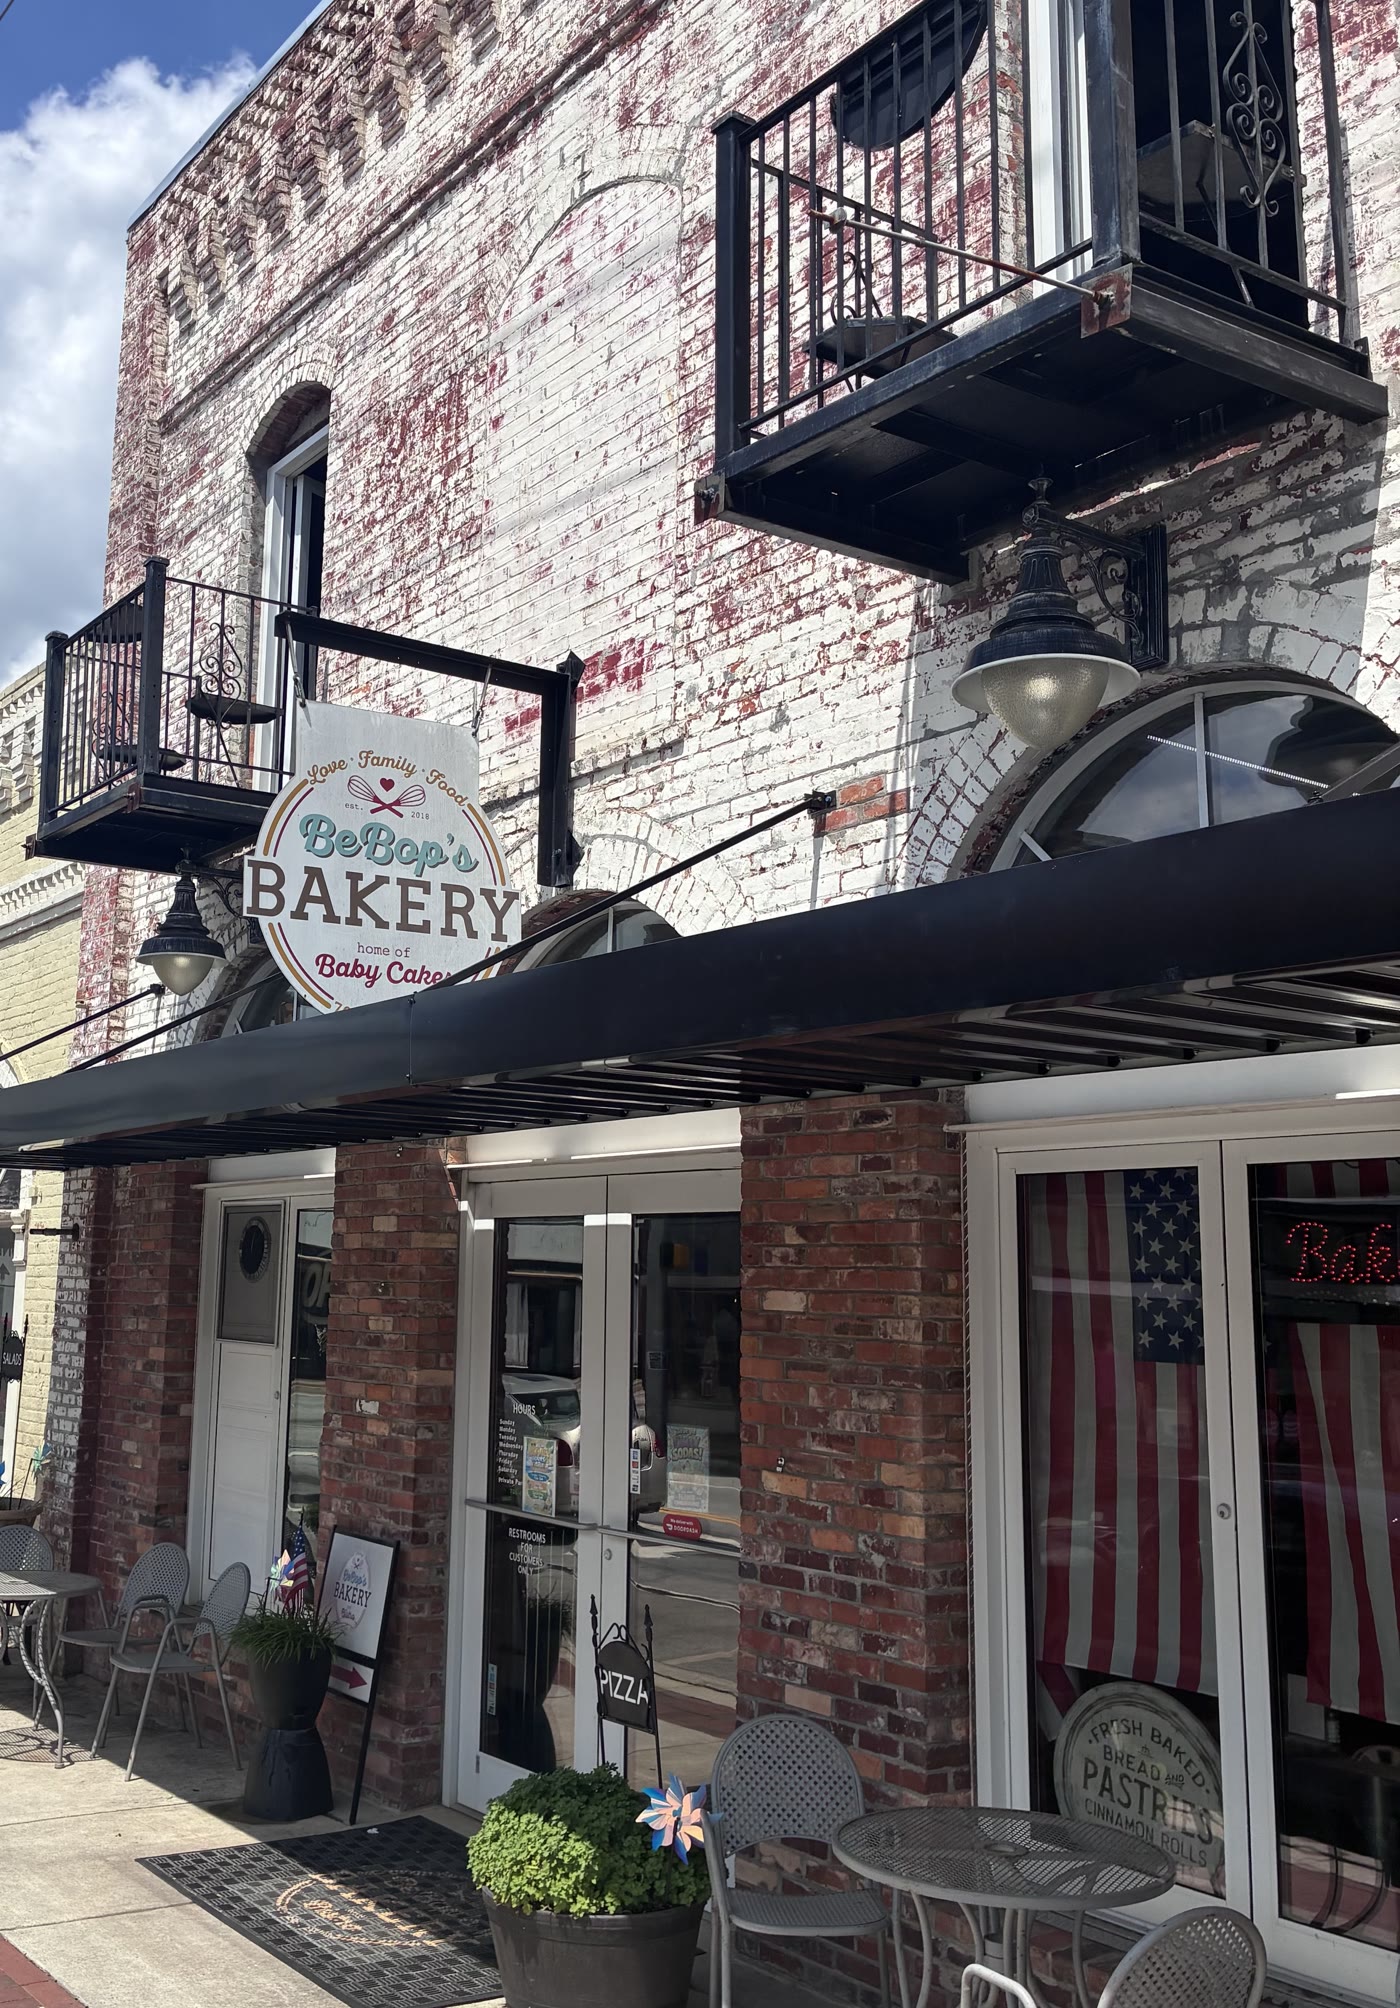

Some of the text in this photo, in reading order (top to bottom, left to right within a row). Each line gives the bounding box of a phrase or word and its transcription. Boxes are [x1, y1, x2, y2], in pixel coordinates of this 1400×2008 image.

[307, 750, 467, 807] Love Family Food
[345, 802, 430, 820] est. 2018
[299, 813, 479, 877] BeBop's
[246, 859, 520, 943] BAKERY
[357, 943, 411, 958] home of
[315, 953, 382, 988] Baby
[1286, 1221, 1400, 1284] Bak
[2, 1352, 22, 1366] SALADS
[512, 1403, 536, 1416] HOURS
[499, 1433, 517, 1442] Tuesday
[499, 1442, 523, 1450] Wednesday
[672, 1447, 703, 1461] SODAS!
[508, 1527, 546, 1544] RESTROOMS
[521, 1542, 533, 1553] FOR
[509, 1552, 543, 1567] CUSTOMERS
[517, 1565, 534, 1576] ONLY
[333, 1581, 372, 1608] BAKERY
[599, 1668, 649, 1705] PIZZA
[1091, 1719, 1206, 1788] FRESH BAKED
[1103, 1745, 1185, 1783] BREAD AND
[1082, 1757, 1213, 1845] PASTRIES
[1085, 1798, 1207, 1868] CINNAMON ROLLS
